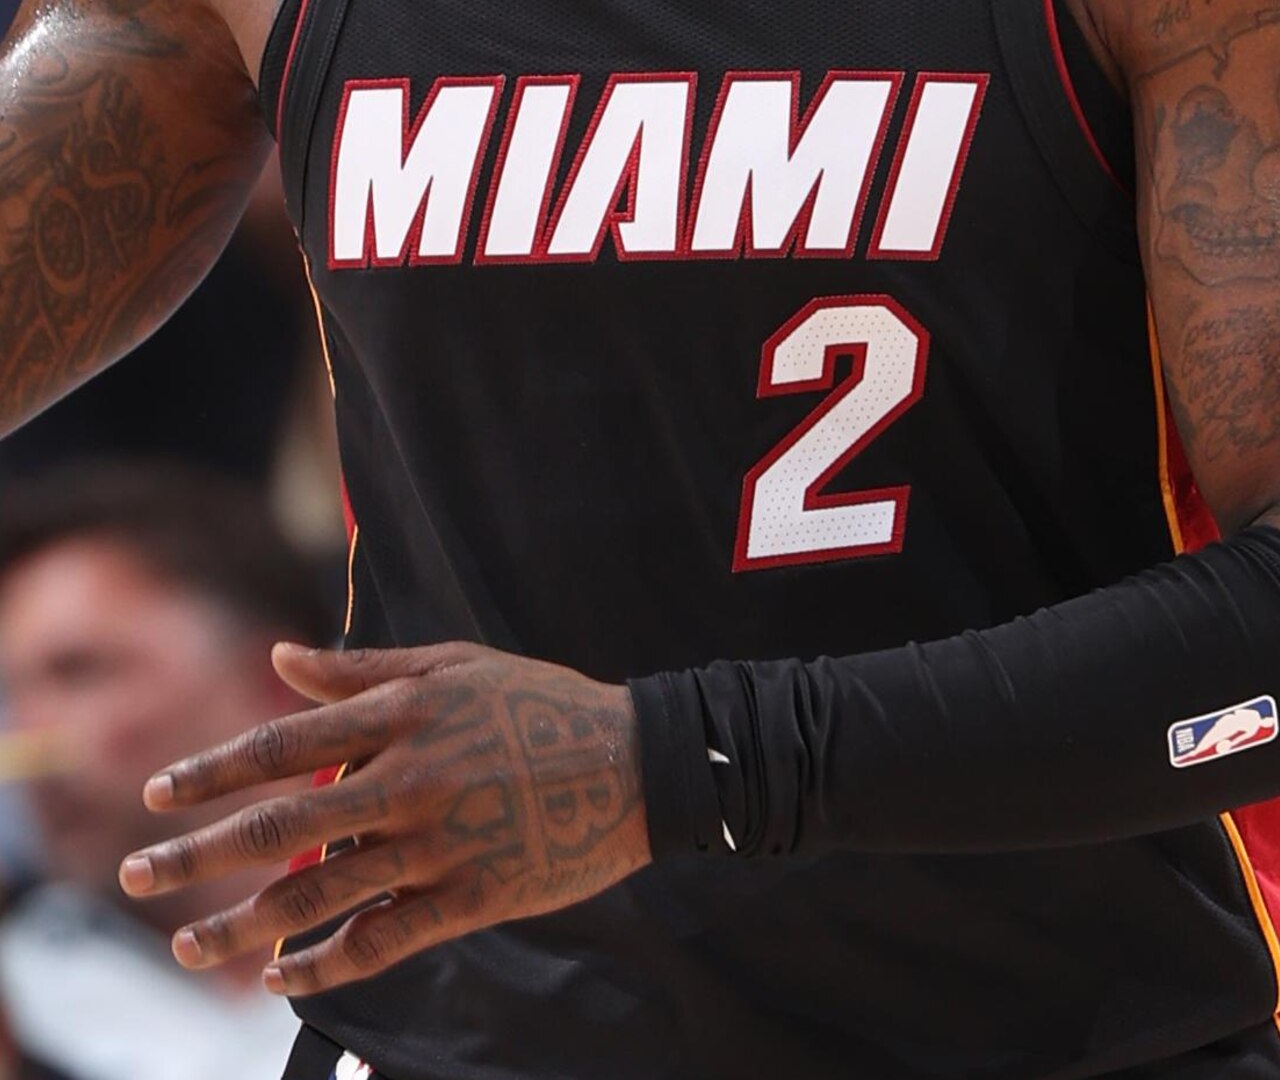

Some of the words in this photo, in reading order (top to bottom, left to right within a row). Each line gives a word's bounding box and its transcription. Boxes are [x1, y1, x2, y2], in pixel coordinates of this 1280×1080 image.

[327, 71, 991, 270] MIAMI
[731, 294, 931, 573] 2
[1175, 727, 1195, 753] NBA
